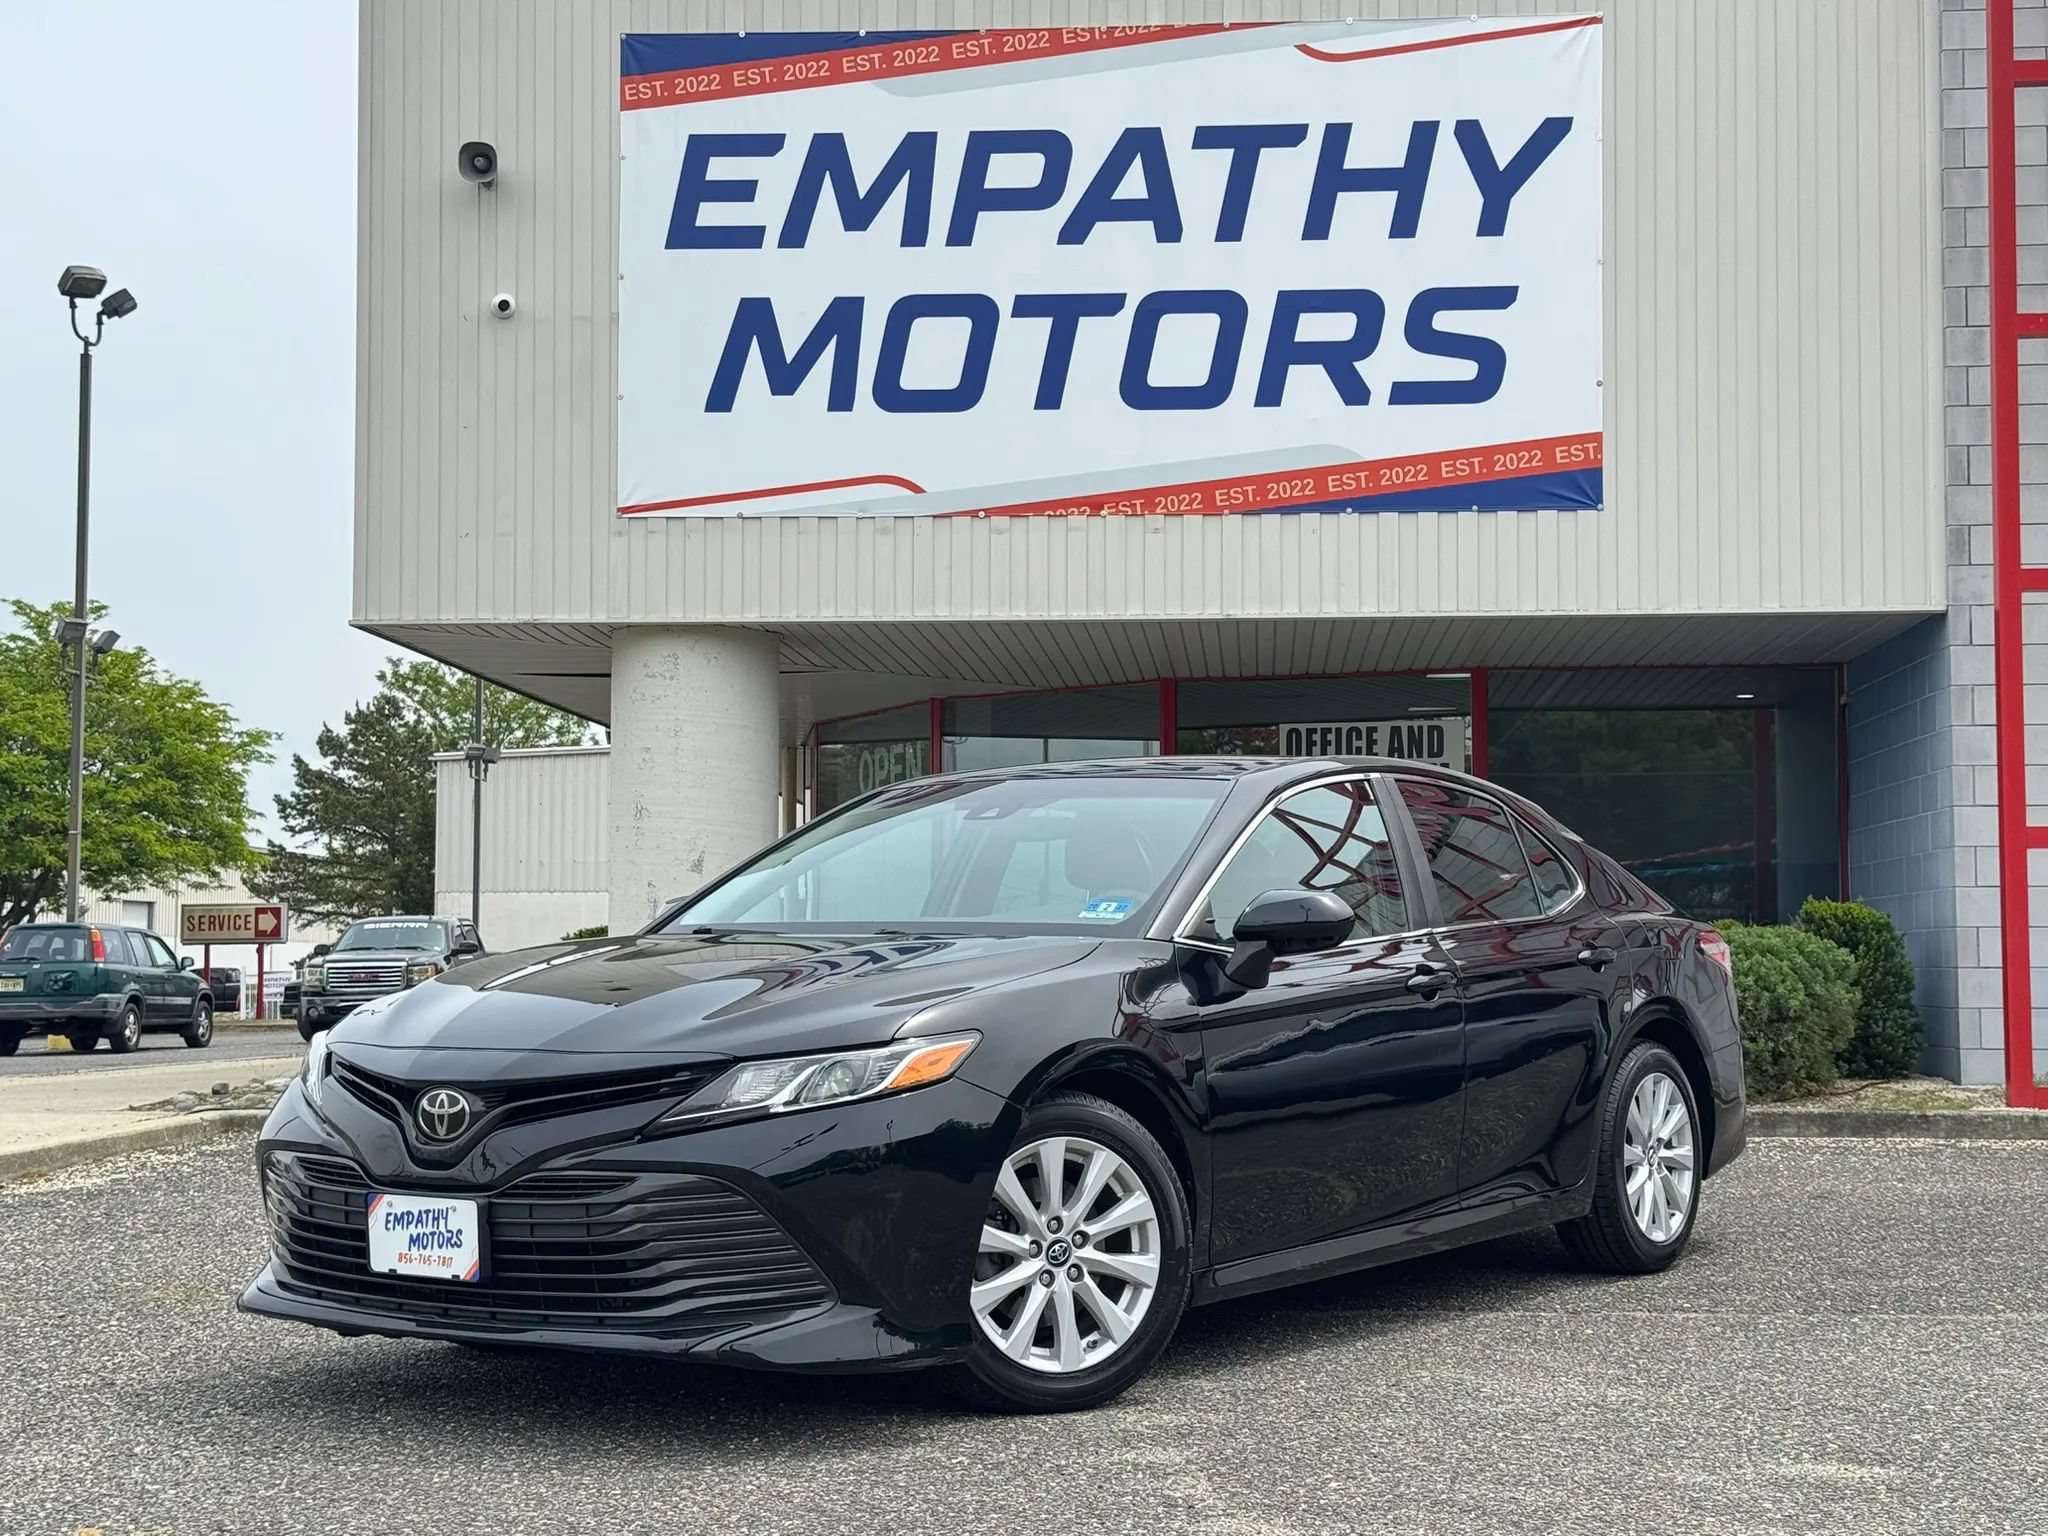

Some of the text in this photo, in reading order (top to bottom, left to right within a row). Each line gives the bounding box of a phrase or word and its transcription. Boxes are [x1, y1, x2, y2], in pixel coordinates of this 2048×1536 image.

[624, 81, 668, 101] EST.
[674, 73, 722, 95] 2022
[733, 66, 778, 88] EST.
[783, 59, 831, 82] 2022
[842, 53, 888, 73] EST.
[893, 45, 940, 67] 2022
[951, 38, 997, 60] EST.
[1003, 30, 1050, 52] 2022
[1062, 26, 1107, 44] EST.
[664, 117, 1574, 250] EMPATHY
[704, 285, 1519, 414] MOTORS
[1155, 492, 1204, 514] 2022
[1215, 485, 1261, 506] EST.
[1267, 478, 1316, 500] 2022
[1327, 471, 1373, 492] EST.
[1379, 464, 1429, 486] 2022
[1441, 456, 1487, 478] EST.
[1493, 449, 1543, 472] 2022
[1555, 443, 1601, 464] EST.
[859, 740, 921, 793] OPEN
[1286, 724, 1445, 759] OFFICE AND
[187, 914, 252, 932] SERVICE
[385, 1207, 449, 1232] EMPATHY
[408, 1229, 463, 1252] MOTORS
